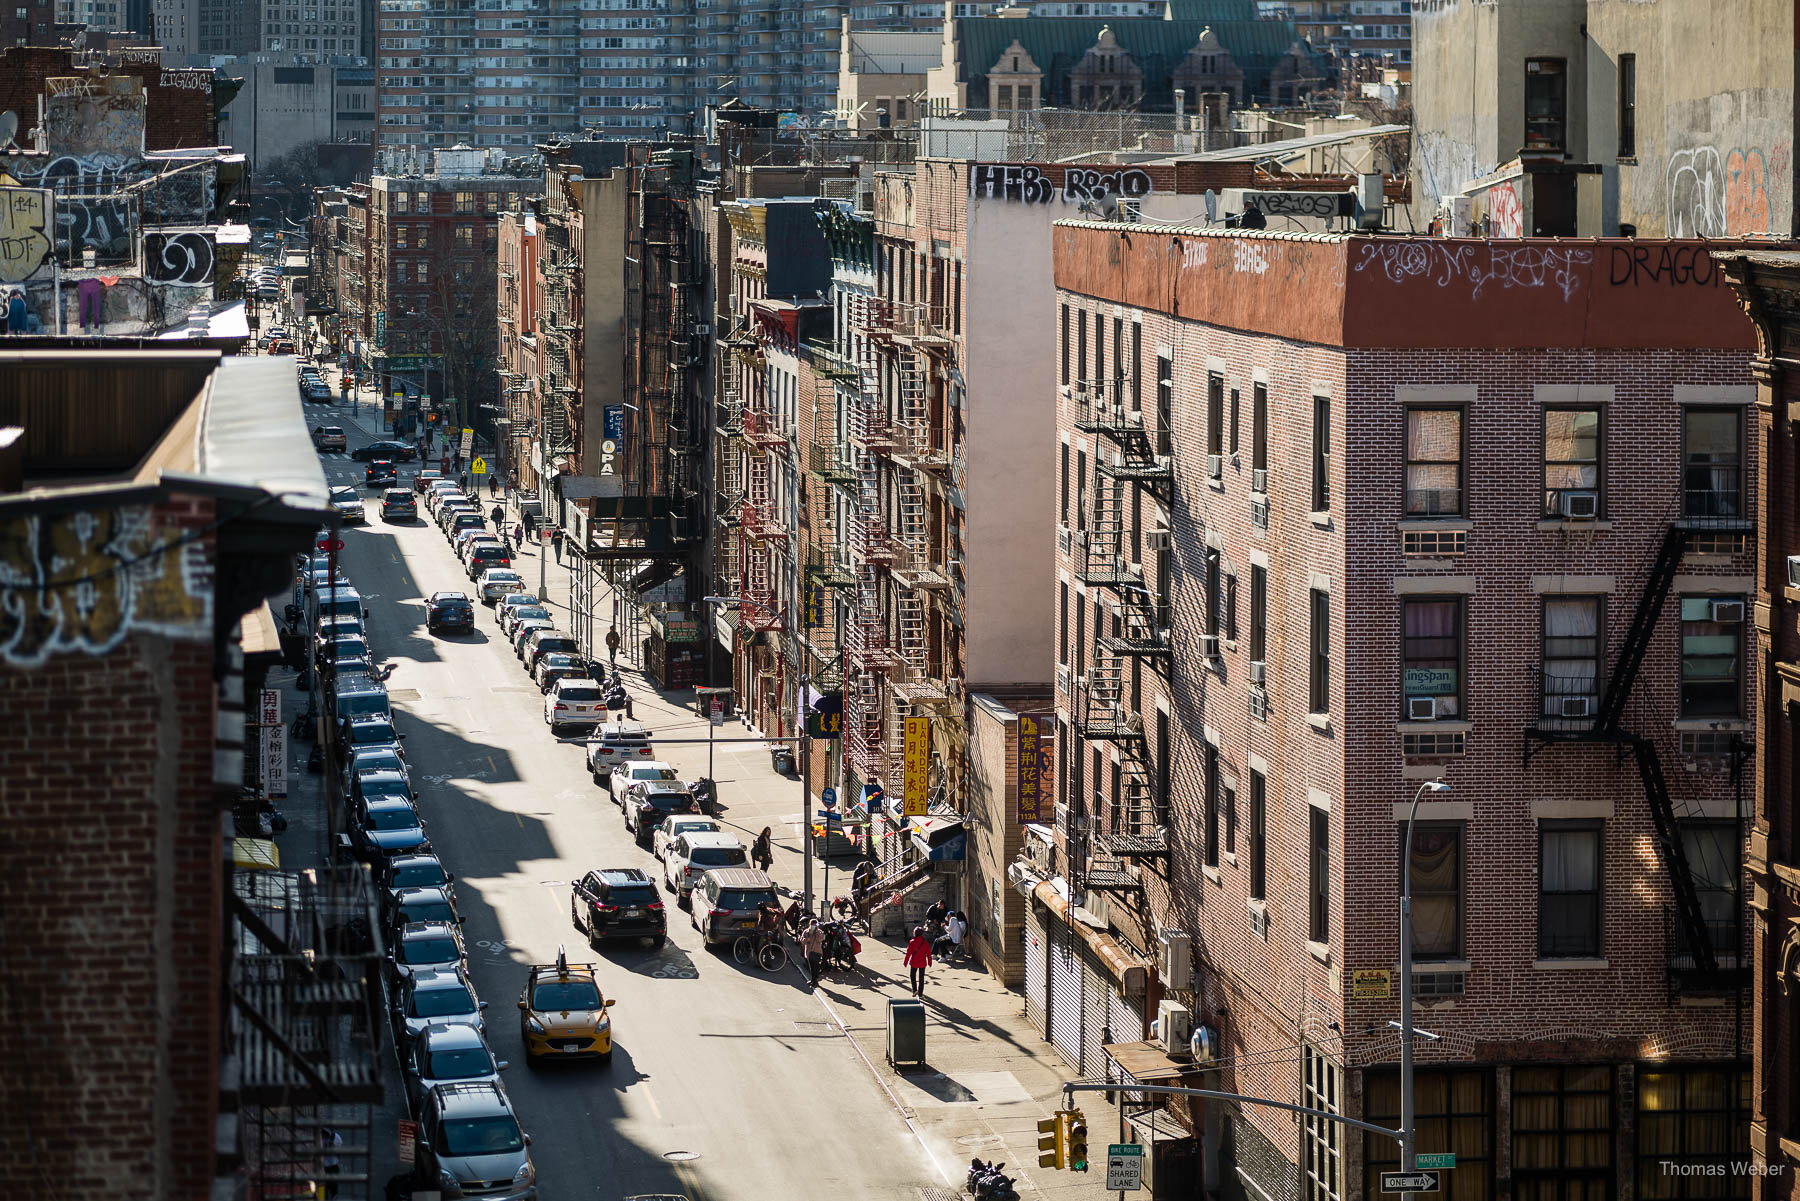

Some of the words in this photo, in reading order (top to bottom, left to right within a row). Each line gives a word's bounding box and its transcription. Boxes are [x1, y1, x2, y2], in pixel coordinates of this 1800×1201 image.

[905, 721, 918, 812] 日月洗衣店
[918, 721, 927, 812] LAUNDROMAT
[1418, 1156, 1446, 1164] MARKET
[1110, 1170, 1139, 1178] SHARED
[1114, 1179, 1134, 1187] LANE
[1389, 1178, 1407, 1187] ONE
[1413, 1178, 1431, 1186] WAY
